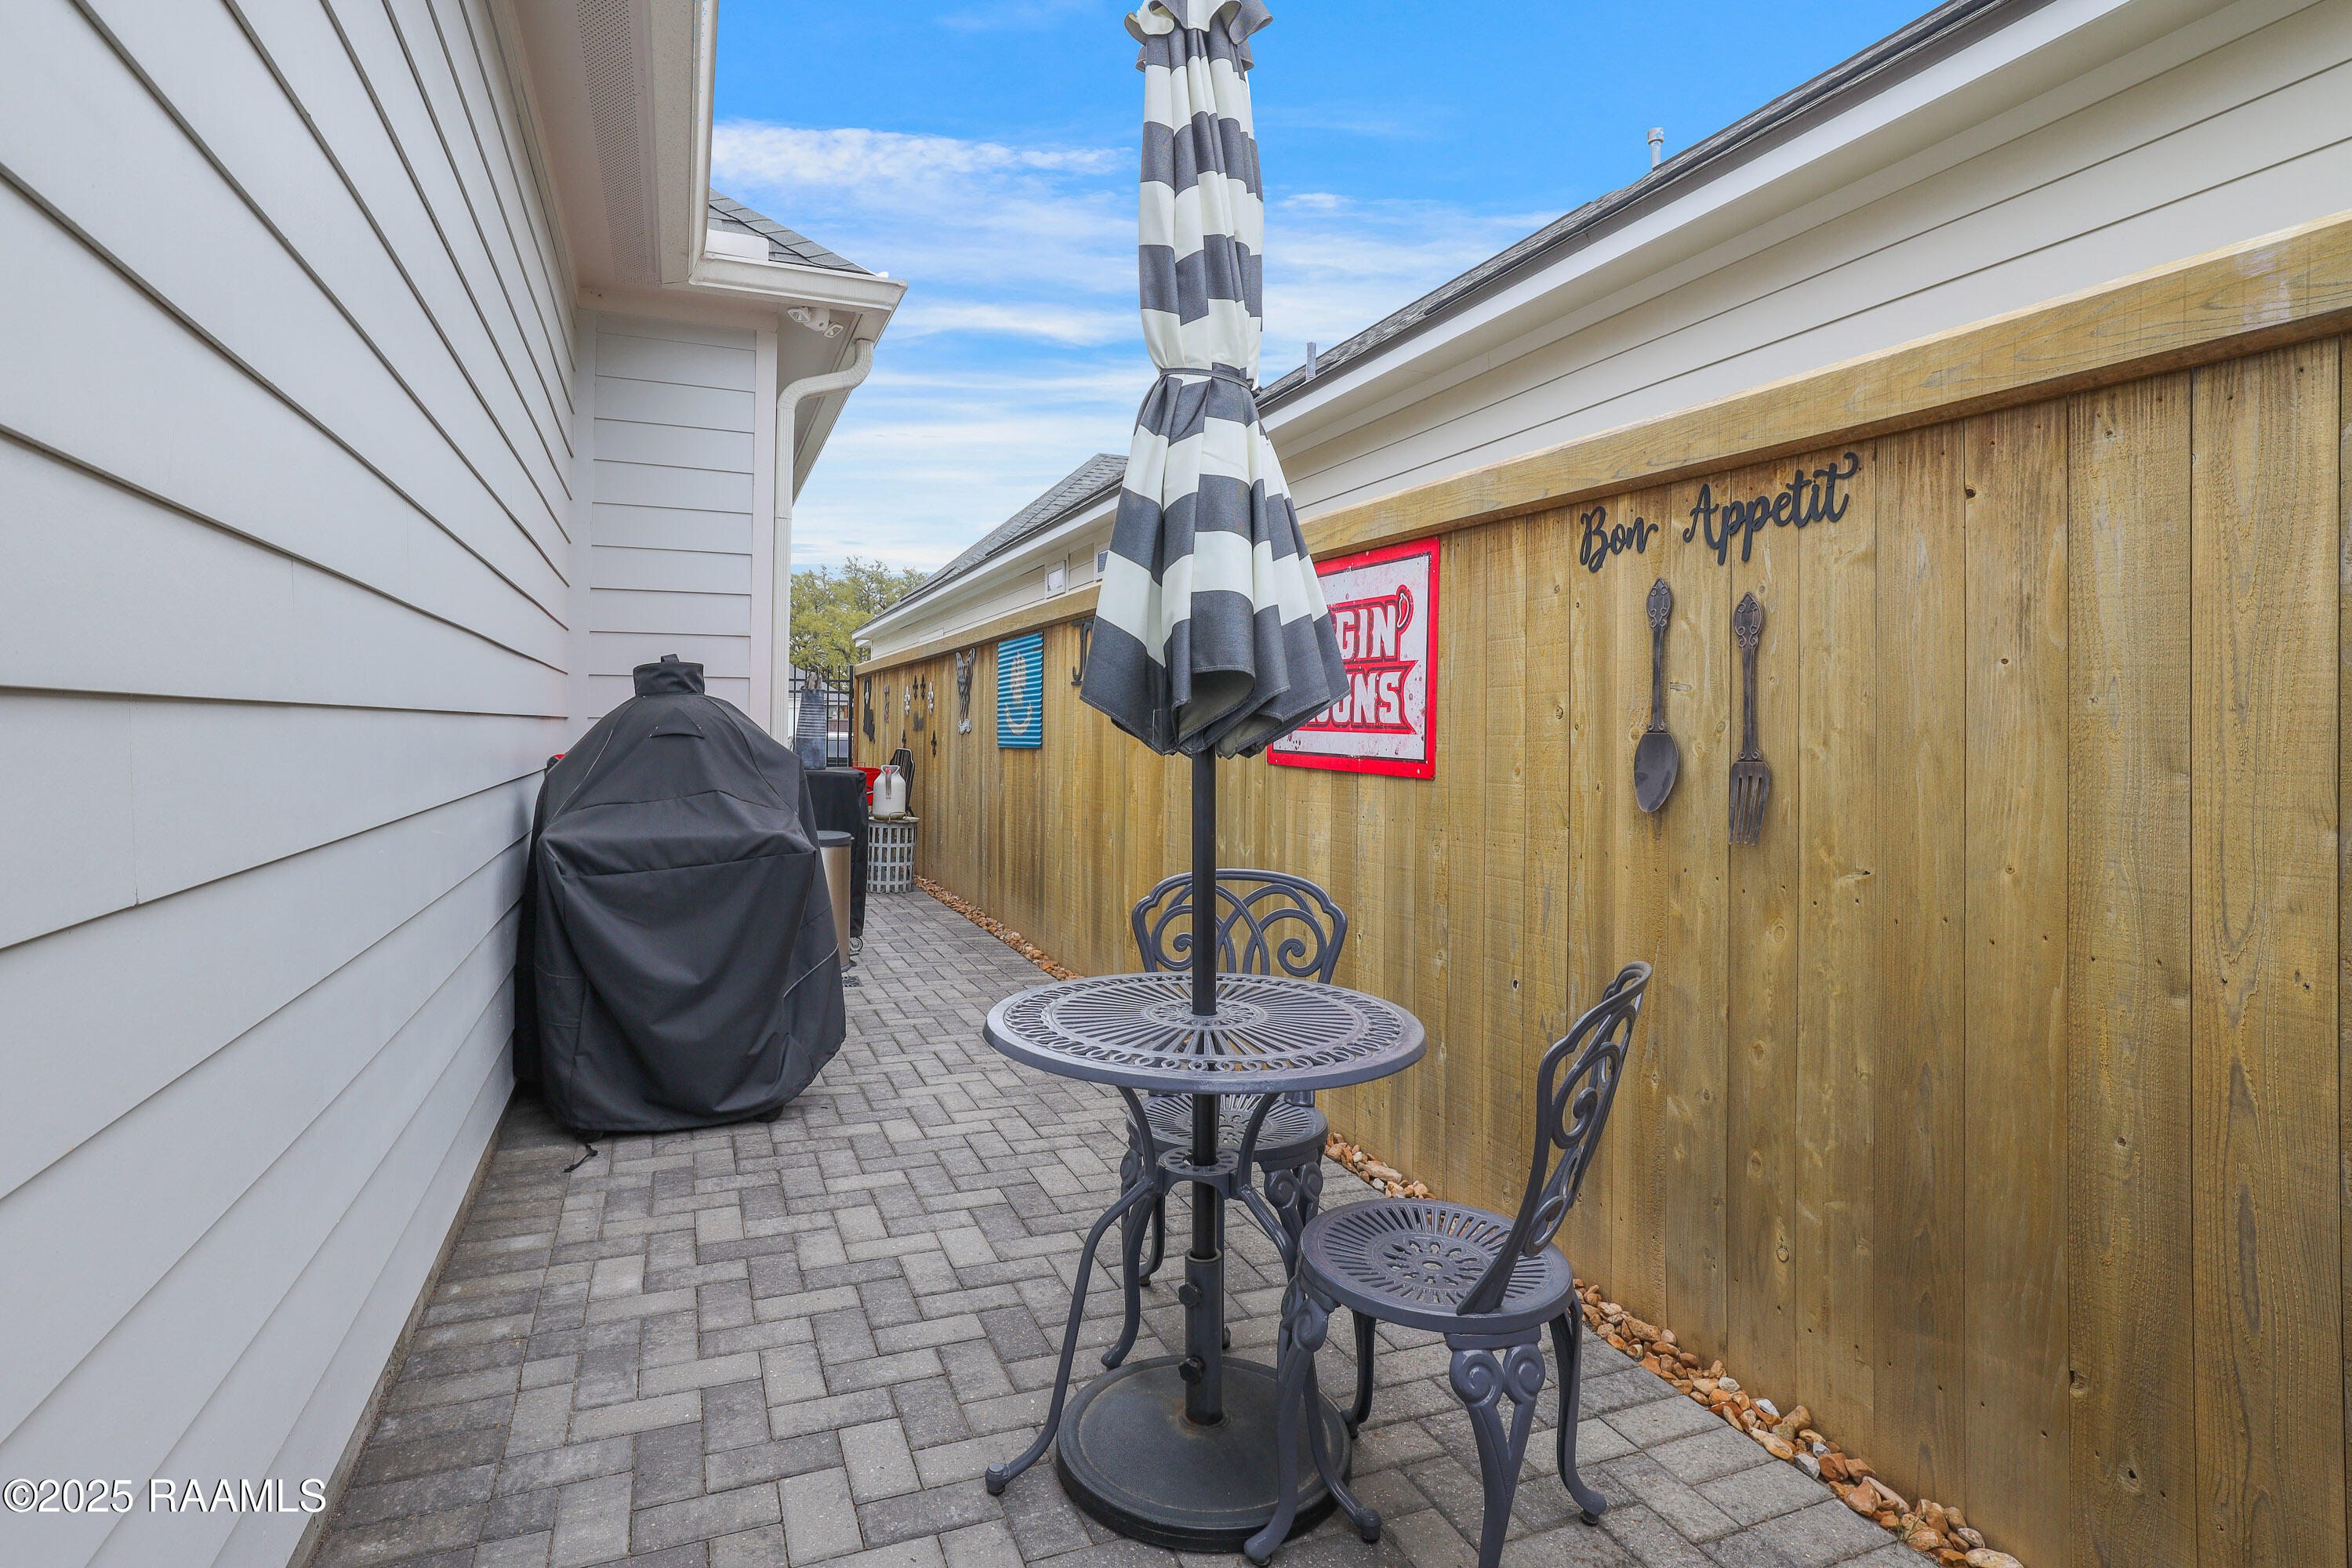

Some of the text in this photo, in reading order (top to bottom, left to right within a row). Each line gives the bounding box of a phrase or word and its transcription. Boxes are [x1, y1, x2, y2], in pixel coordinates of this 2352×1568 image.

[1579, 452, 1859, 573] Bon Appetit
[1334, 593, 1410, 660] GIN'
